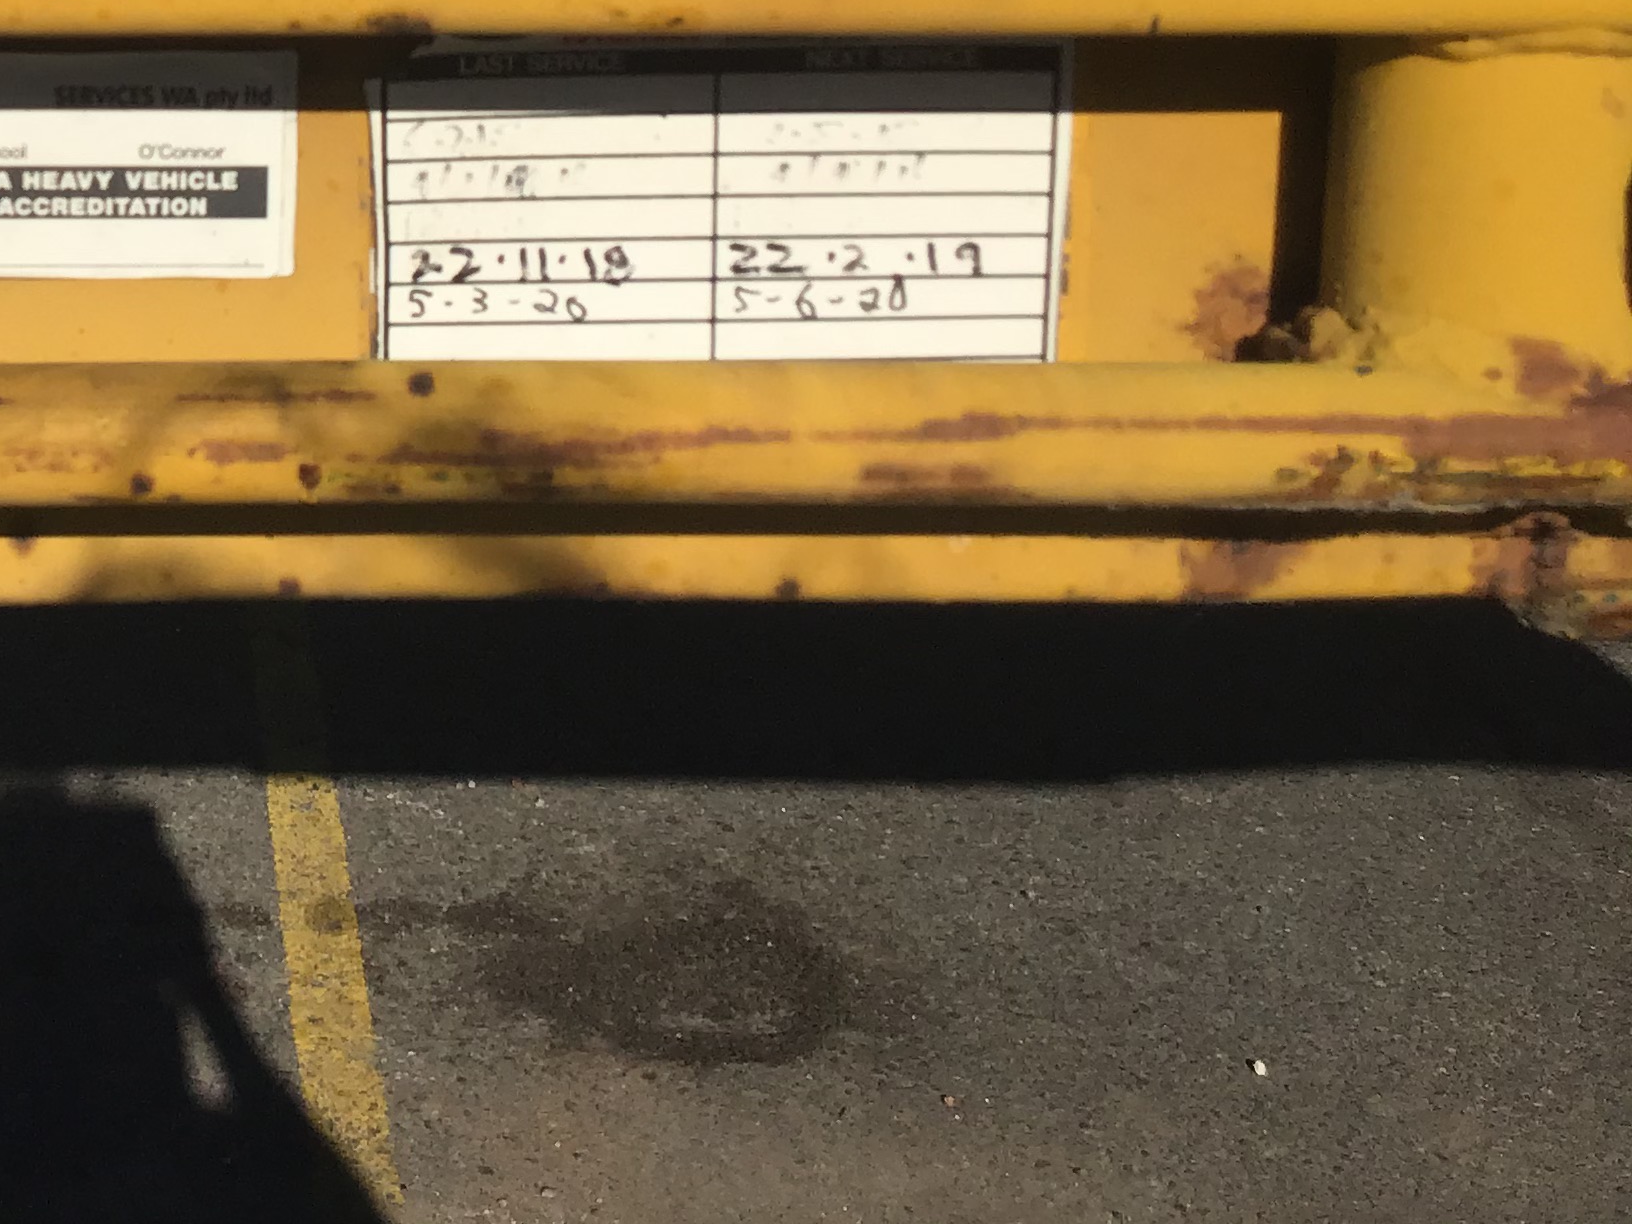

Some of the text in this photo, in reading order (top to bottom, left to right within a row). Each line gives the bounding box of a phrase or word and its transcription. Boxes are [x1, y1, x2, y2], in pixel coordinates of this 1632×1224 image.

[160, 85, 198, 105] WA
[137, 143, 226, 160] O'Connor
[21, 170, 115, 191] HEAVY
[124, 170, 239, 191] VEHICLE
